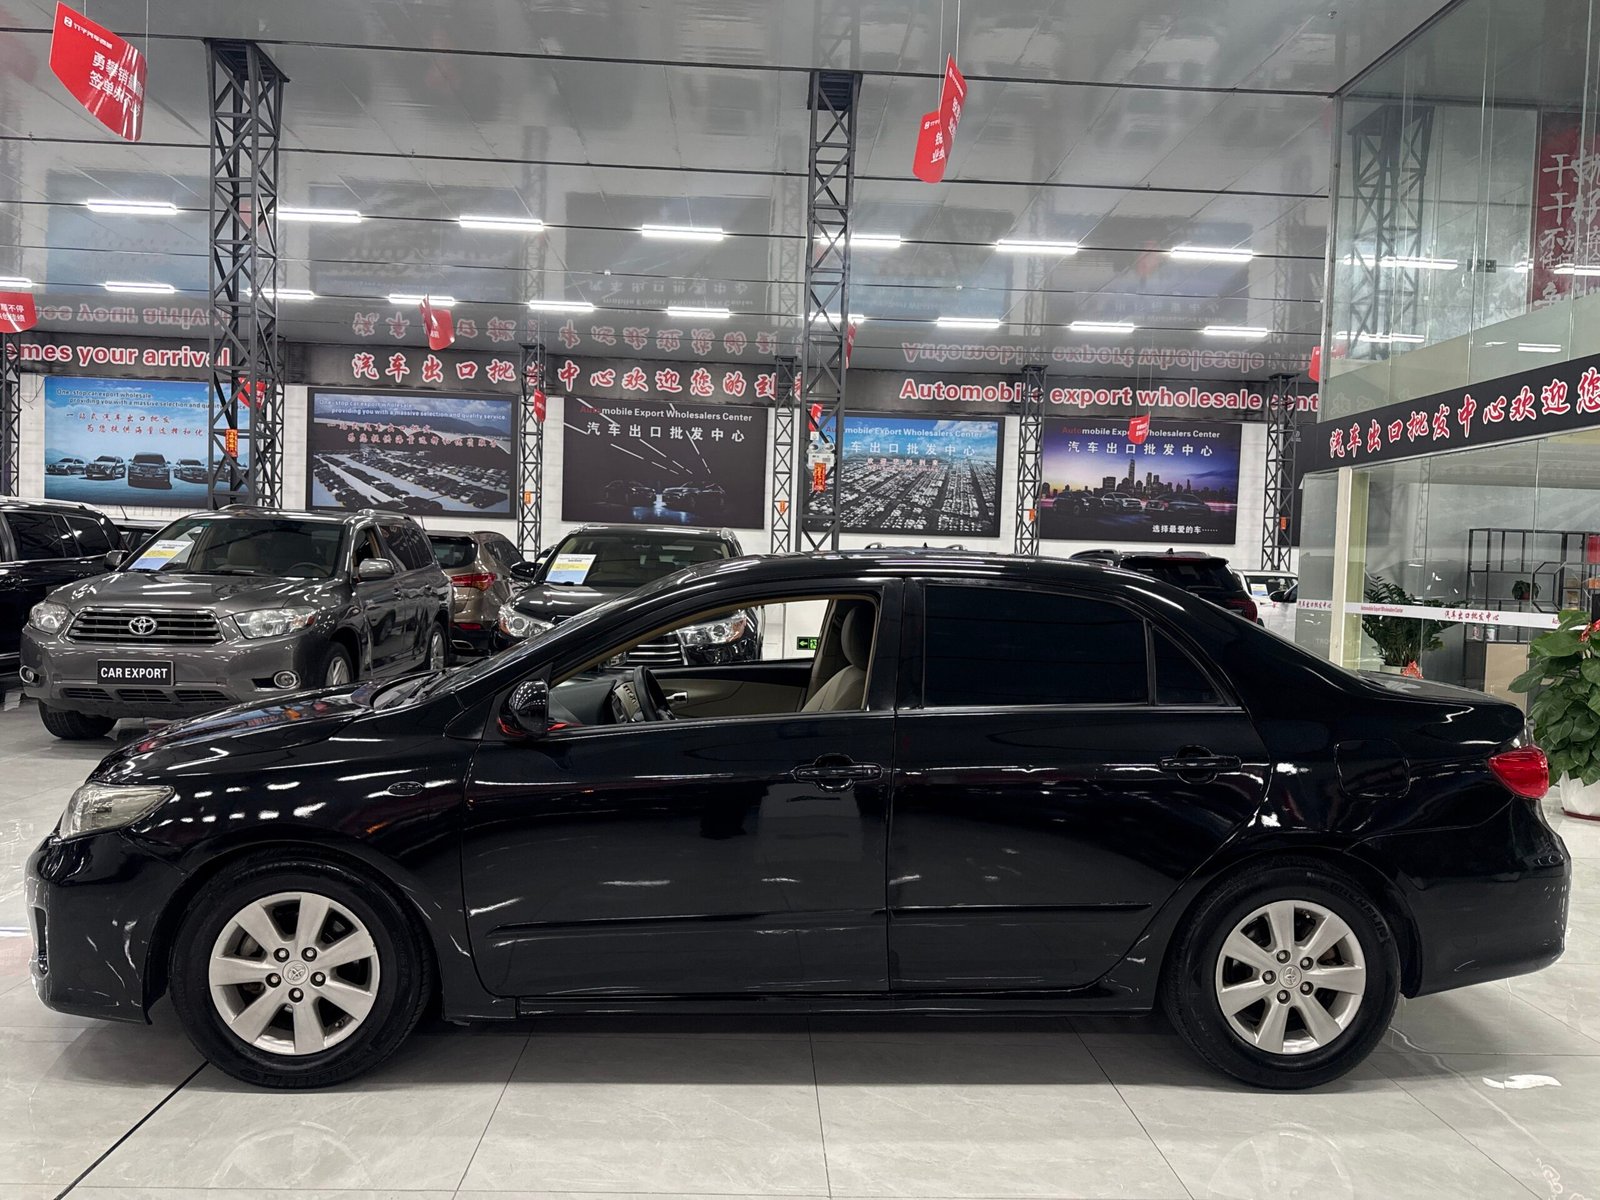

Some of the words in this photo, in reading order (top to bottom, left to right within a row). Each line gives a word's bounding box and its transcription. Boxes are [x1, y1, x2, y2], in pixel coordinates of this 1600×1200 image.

[76, 346, 138, 367] your
[143, 346, 230, 367] arrivl
[70, 398, 99, 406] providing
[1050, 386, 1132, 408] export
[1137, 386, 1263, 410] wholesale
[331, 407, 361, 416] providing
[362, 409, 374, 417] you
[579, 406, 632, 416] Automobile
[635, 408, 664, 418] Export
[666, 409, 721, 420] Wholesalers
[723, 412, 752, 422] Center
[1329, 366, 1600, 458] 汽车出口批发中心欢迎您
[86, 424, 204, 437] 为您提供海量选择和优
[587, 421, 744, 443] 汽车出口批发中心
[826, 426, 873, 434] Aumobile
[875, 427, 901, 437] Export
[903, 428, 954, 437] Wholesalers
[955, 430, 982, 438] Center
[1062, 426, 1110, 436] Automobile
[1148, 428, 1192, 438] holesalers
[1193, 430, 1220, 439] Center
[843, 441, 975, 457] 车出口批发中心
[1068, 440, 1213, 457] 汽车出口批发中心
[1444, 610, 1500, 622] 汽车出口批发中心
[100, 667, 123, 678] CAR
[124, 667, 168, 679] EXPORT
